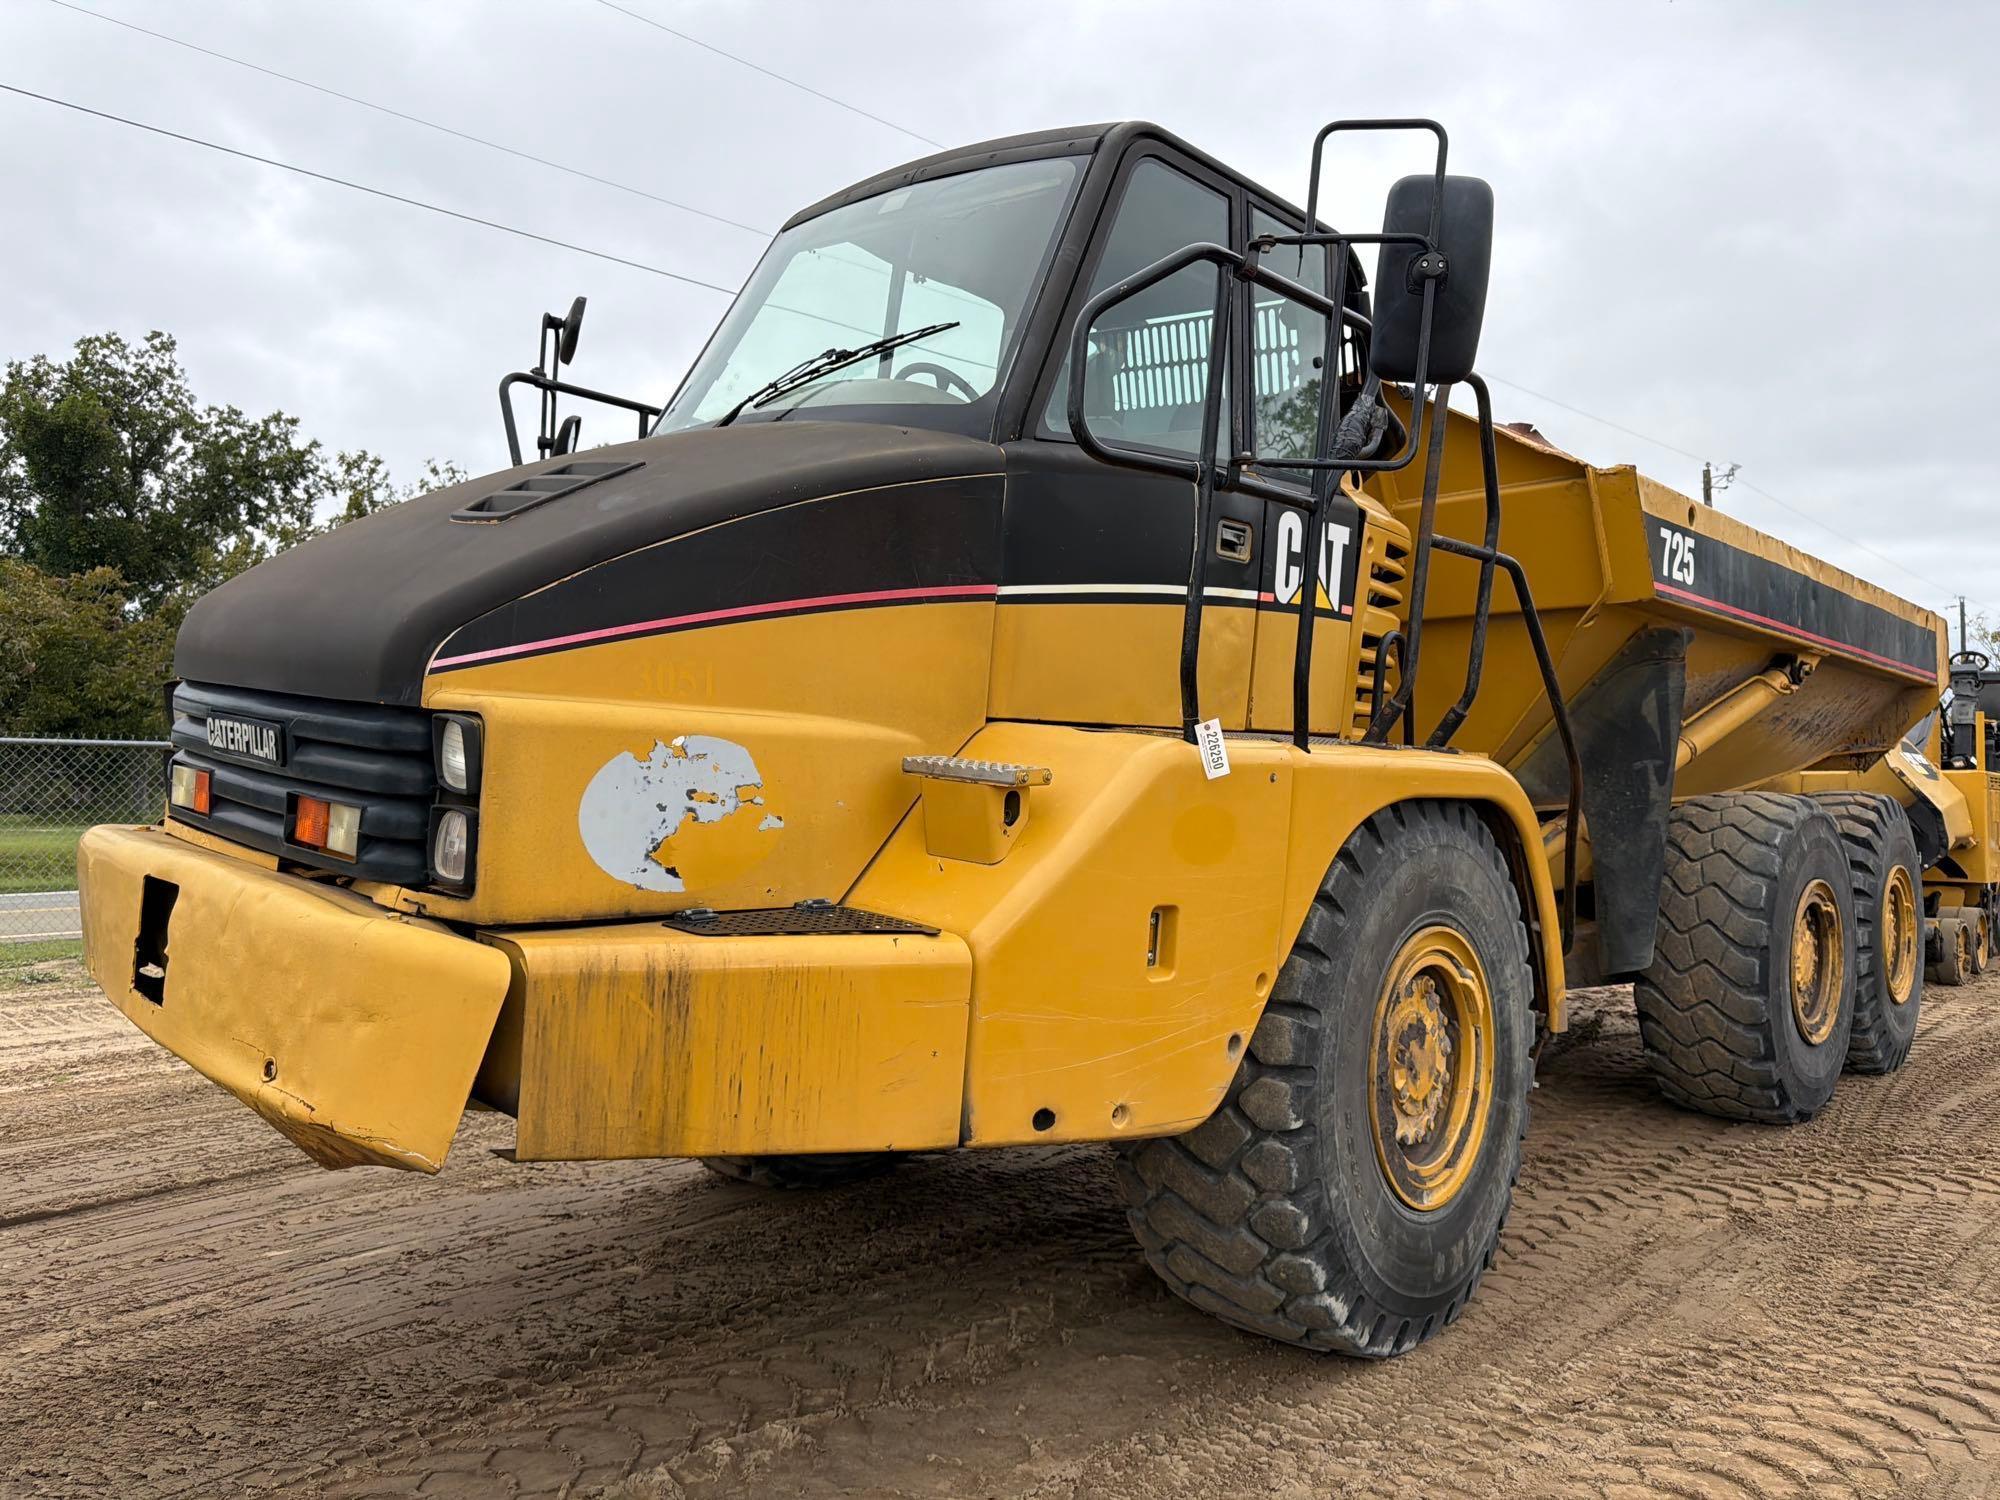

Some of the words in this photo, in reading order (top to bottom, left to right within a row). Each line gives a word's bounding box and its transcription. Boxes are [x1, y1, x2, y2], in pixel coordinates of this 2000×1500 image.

[1660, 527, 1695, 586] 725
[633, 658, 714, 698] 3051
[206, 717, 277, 761] CATERPILLAR
[1206, 731, 1225, 770] 226250
